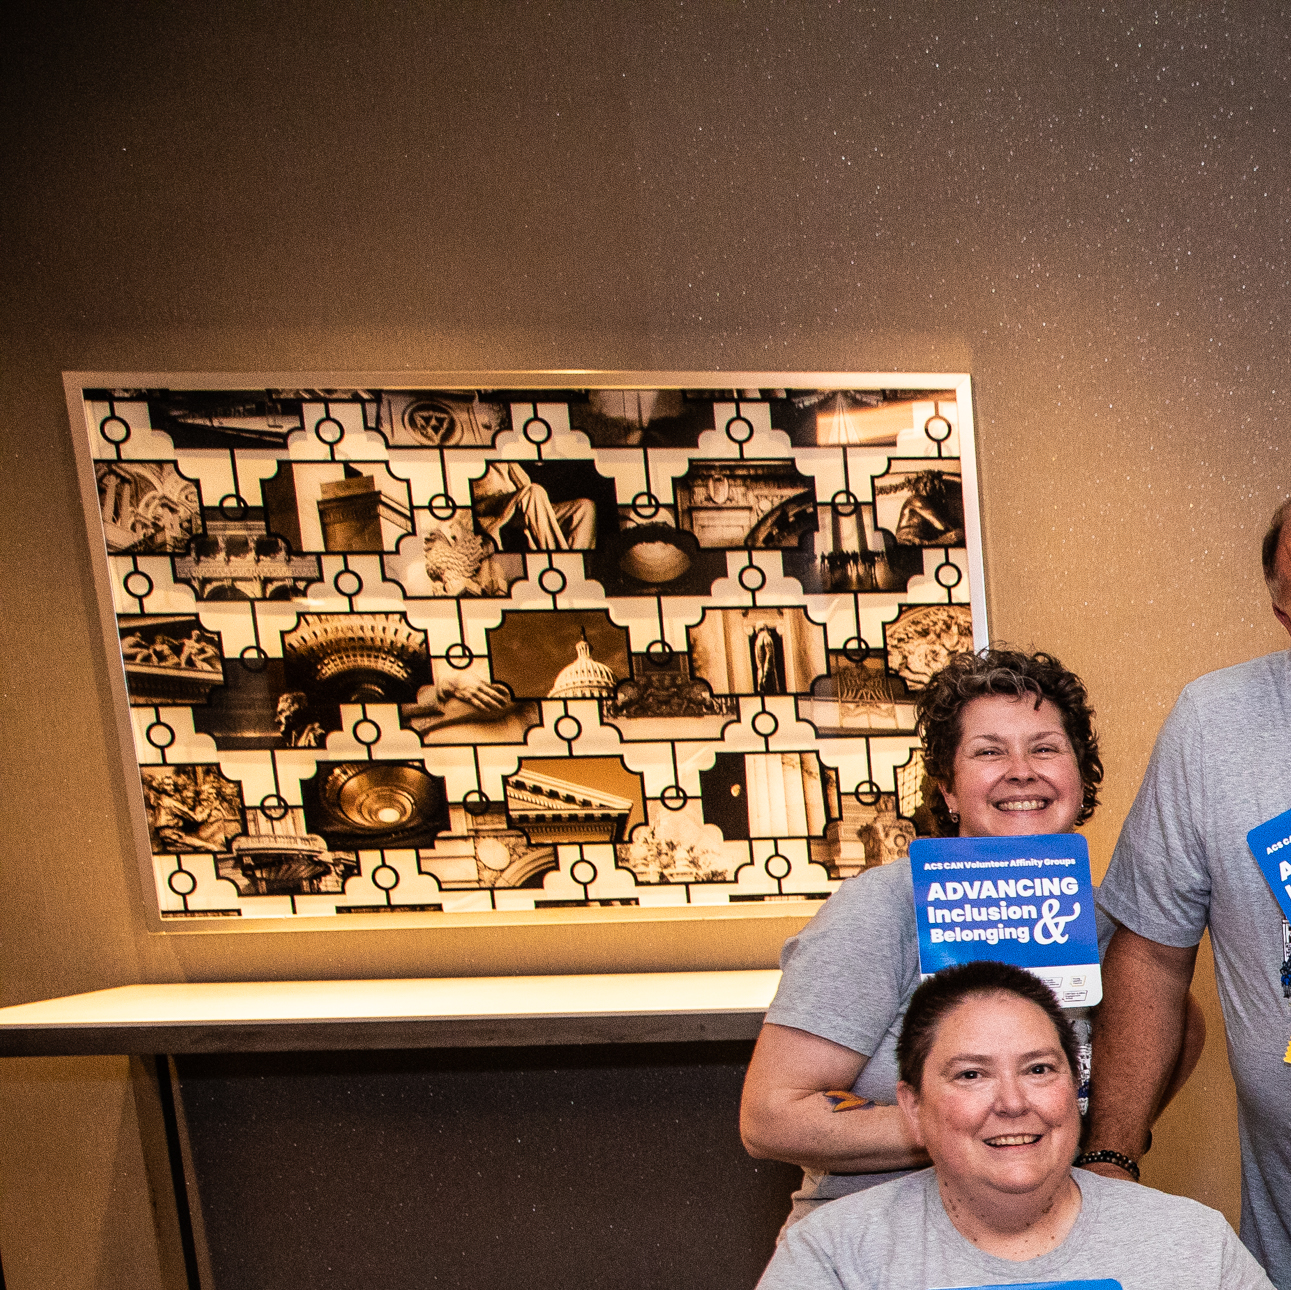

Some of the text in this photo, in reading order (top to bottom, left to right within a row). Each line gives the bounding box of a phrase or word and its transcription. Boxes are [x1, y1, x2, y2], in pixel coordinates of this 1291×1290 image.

[1266, 842, 1281, 855] ACS
[924, 858, 1076, 871] ACS CAN Volunteer Affinity Groups
[927, 877, 1078, 901] ADVANCING
[928, 899, 1081, 945] Inclusion &
[931, 924, 1030, 945] Belonging
